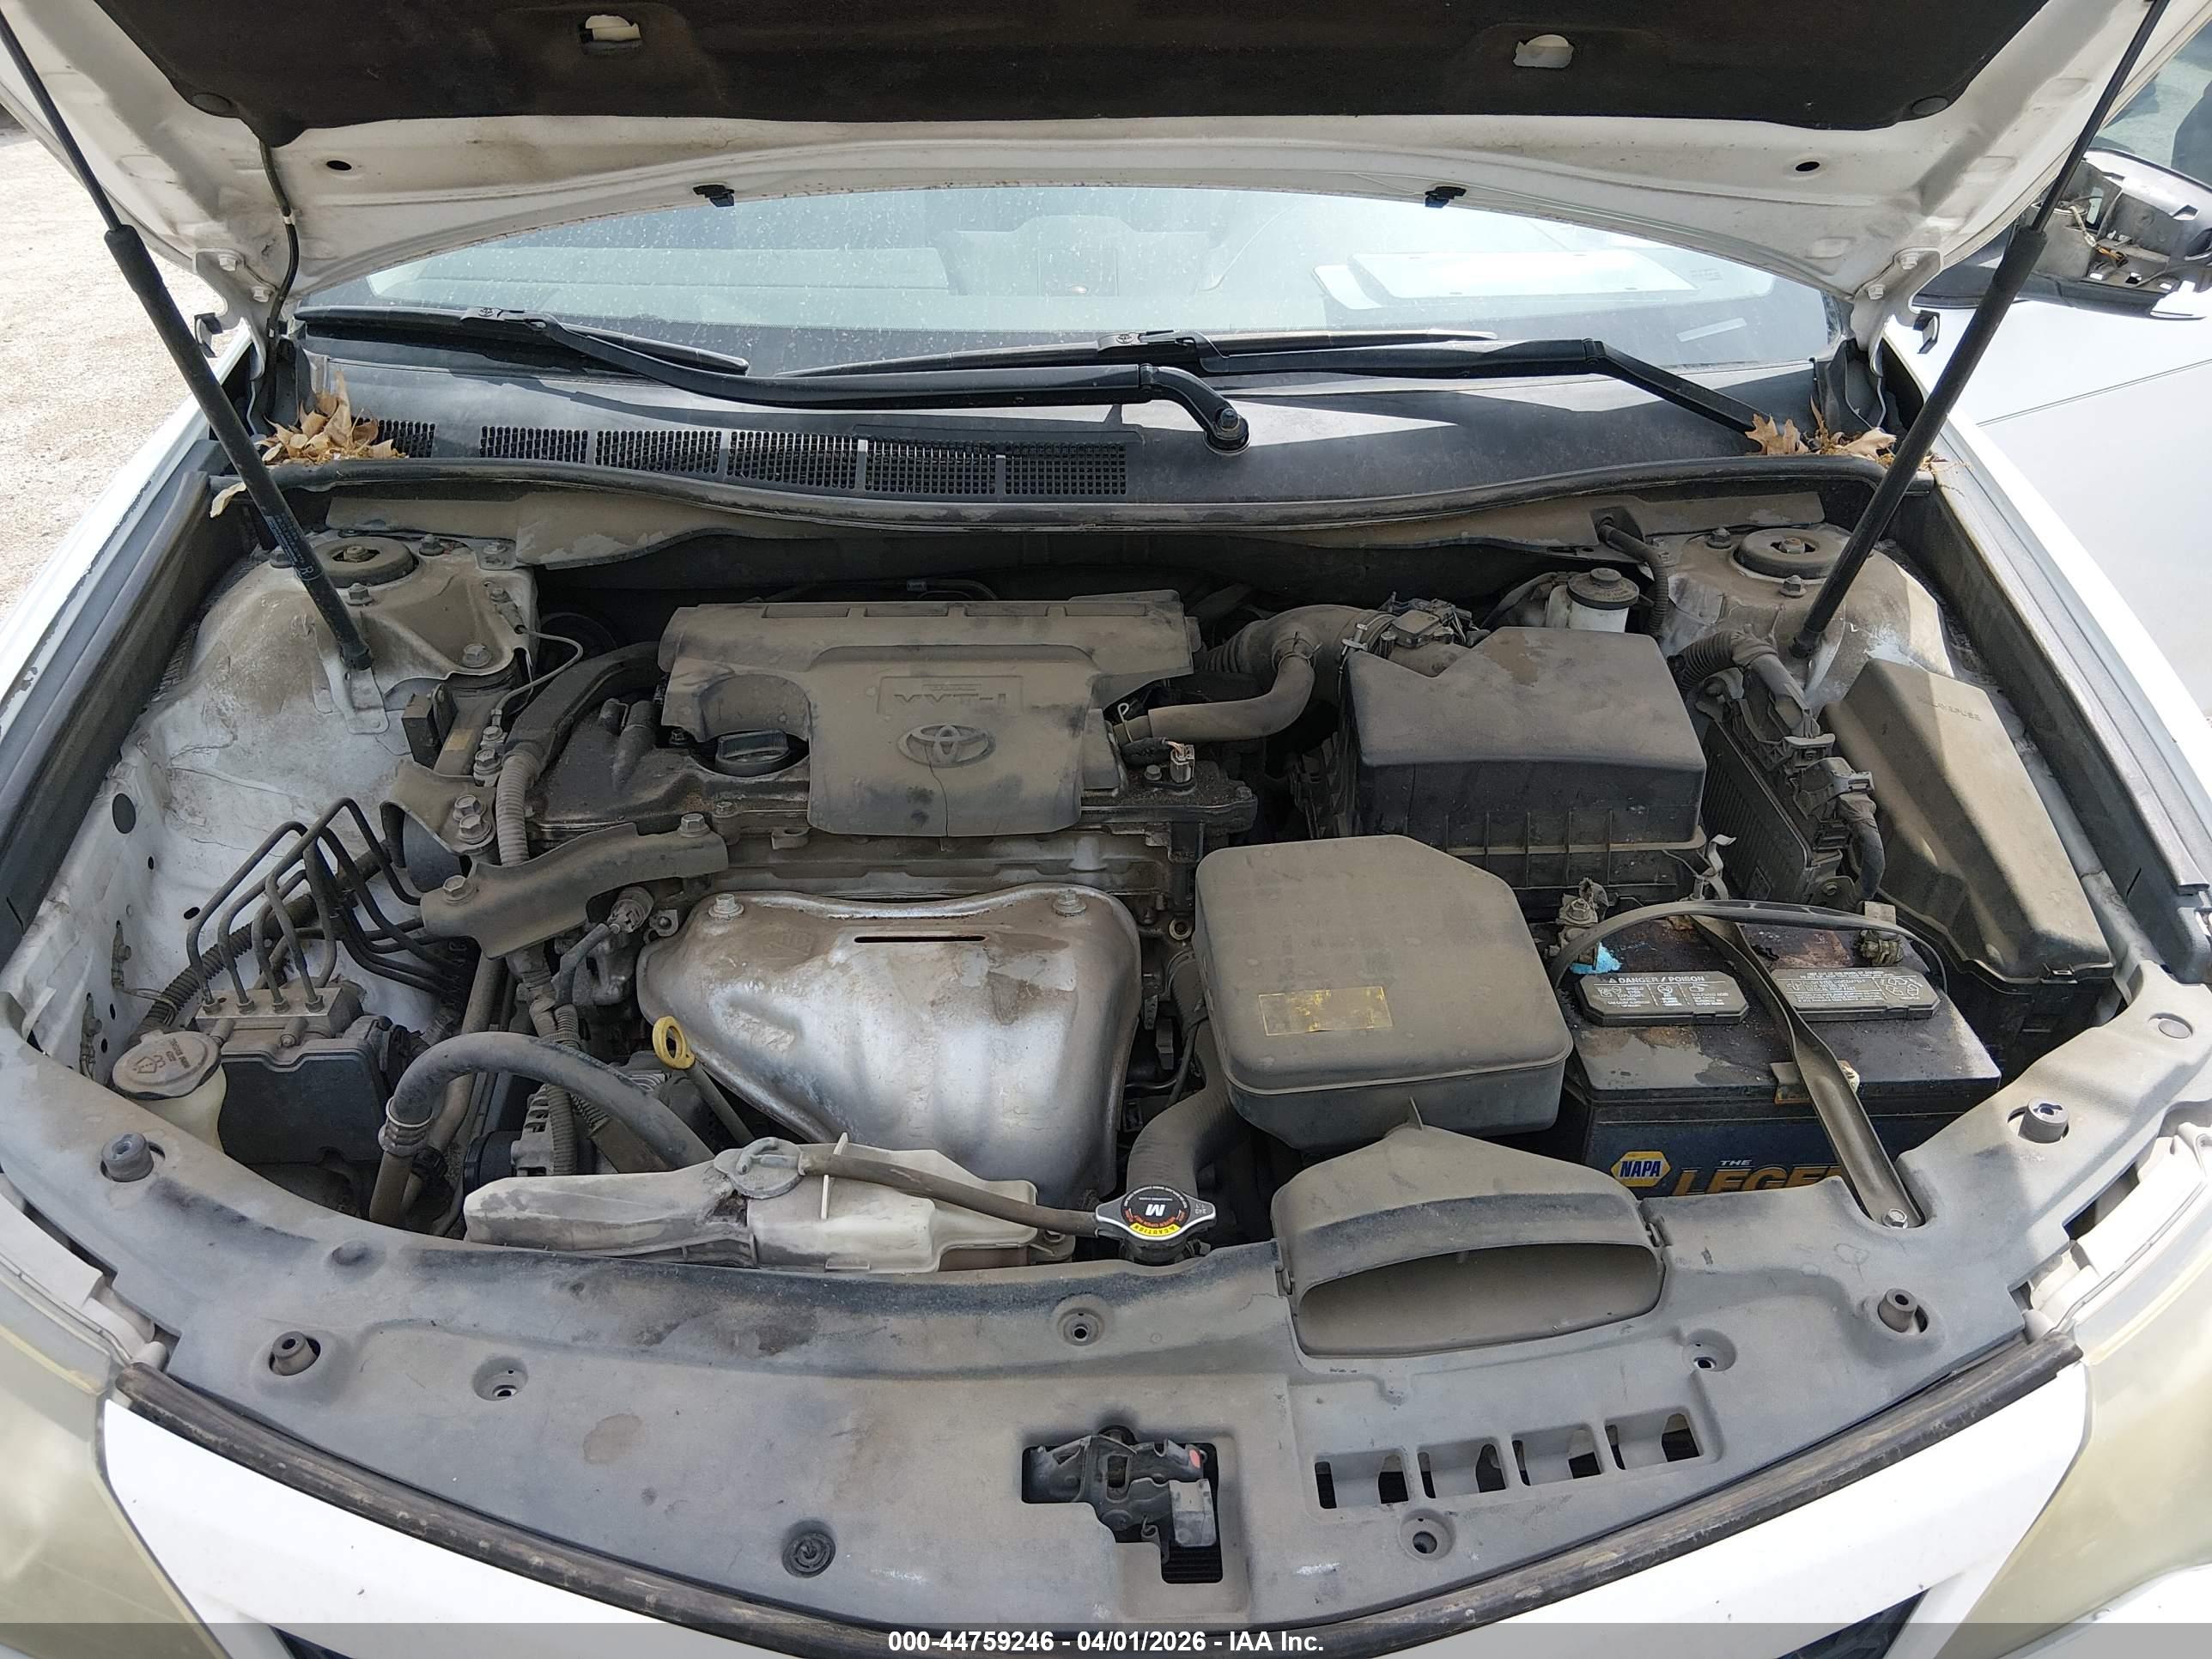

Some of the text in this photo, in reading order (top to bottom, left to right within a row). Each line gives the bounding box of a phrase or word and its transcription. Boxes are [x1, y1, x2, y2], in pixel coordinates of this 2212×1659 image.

[1620, 1160, 1662, 1177] NAPA
[1671, 1166, 1841, 1196] LEGE
[1133, 1225, 1169, 1235] CAUTION
